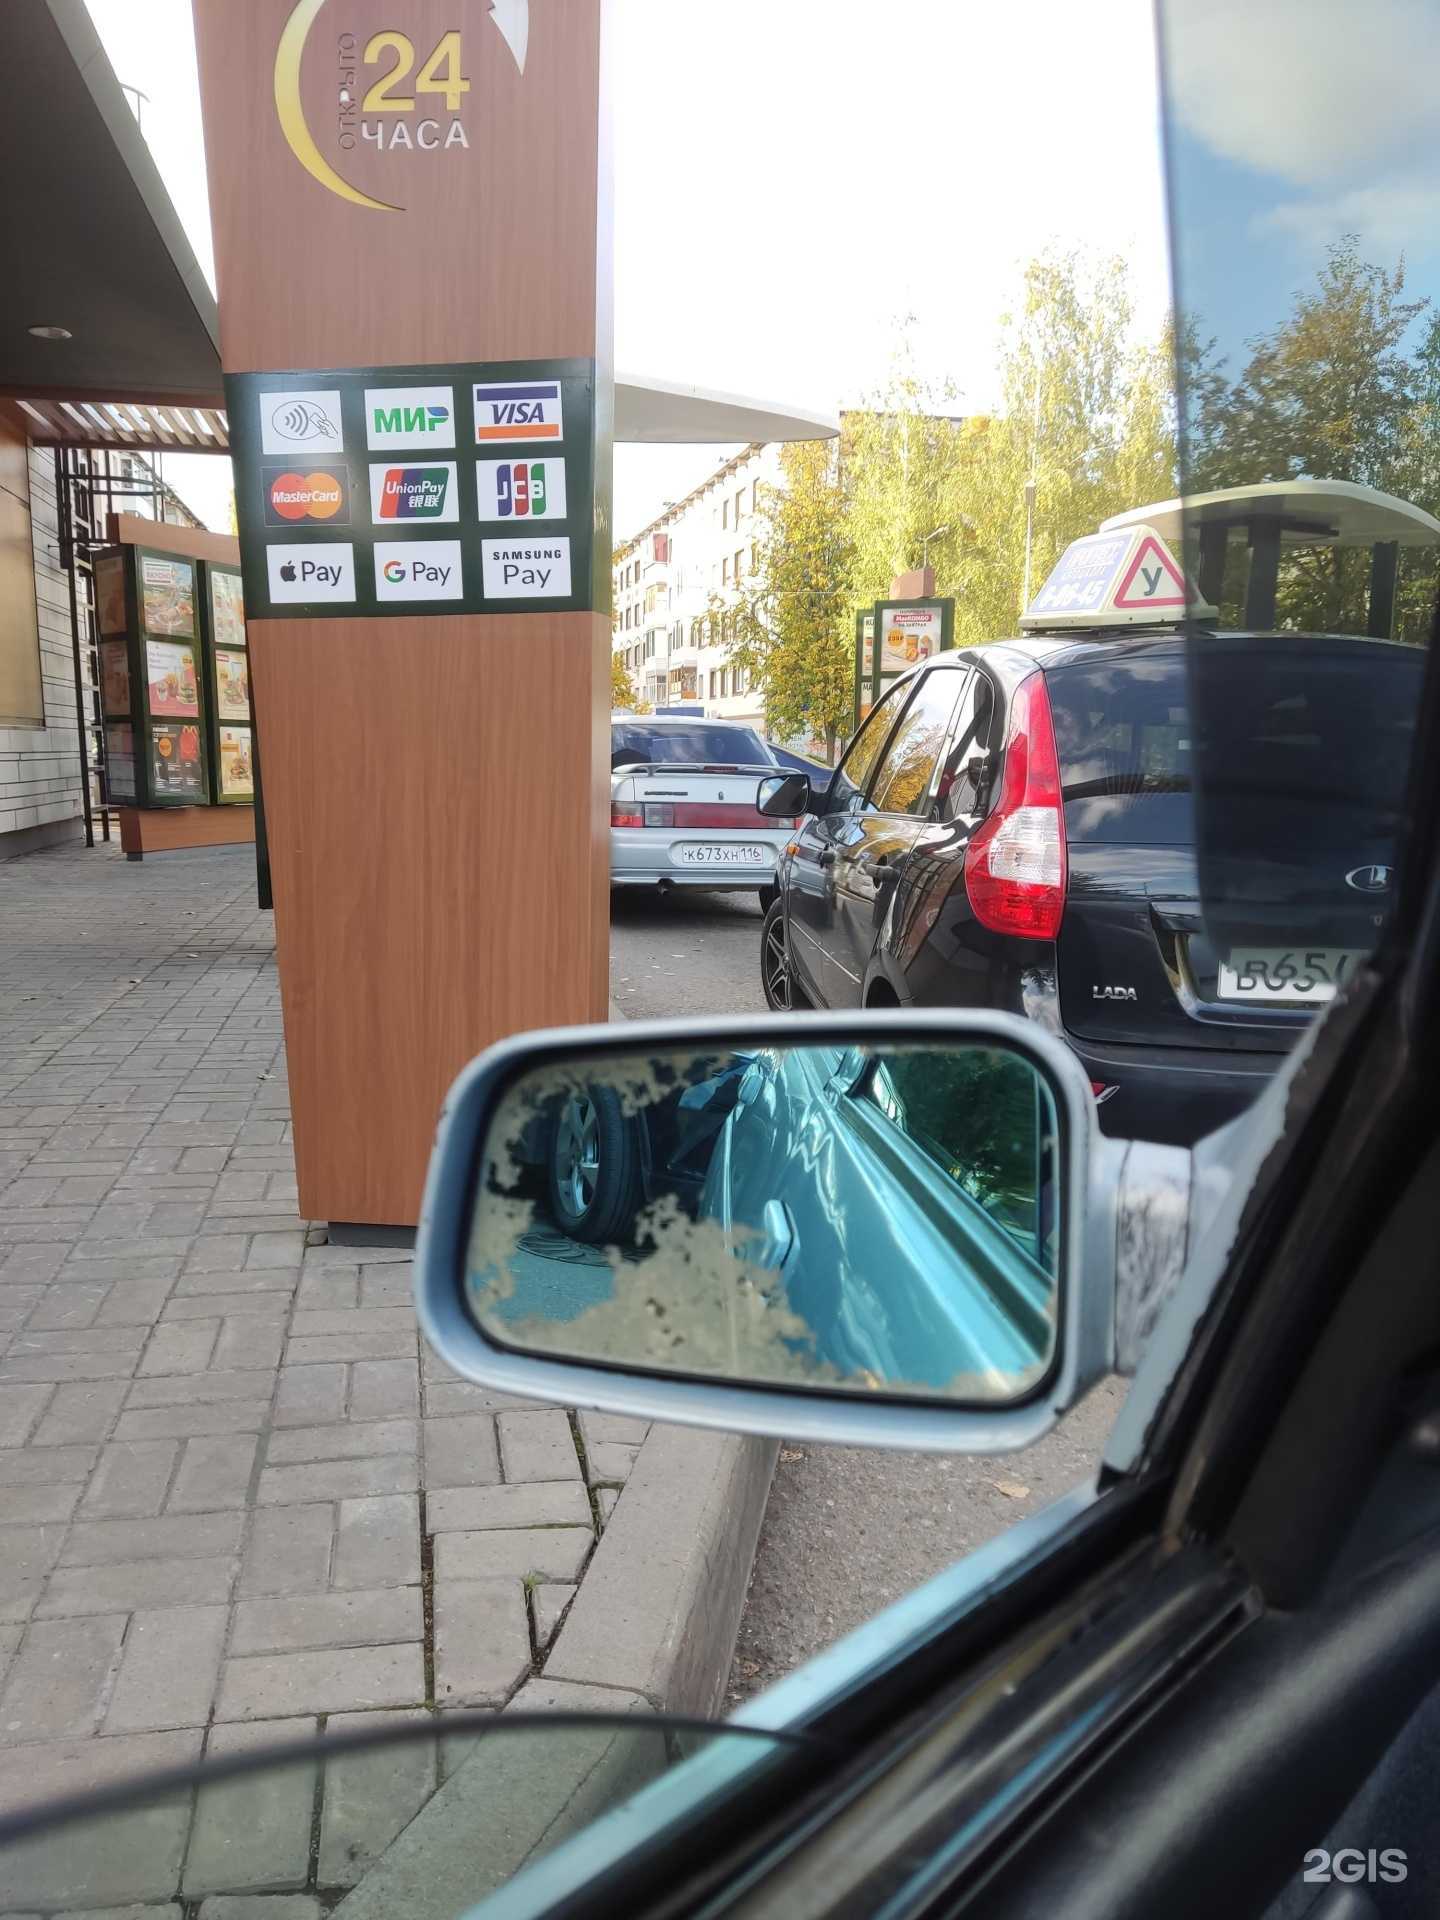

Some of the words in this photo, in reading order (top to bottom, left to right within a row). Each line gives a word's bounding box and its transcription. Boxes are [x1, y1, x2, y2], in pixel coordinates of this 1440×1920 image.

[362, 30, 471, 112] 24
[338, 32, 356, 150] ОТКРЫТО
[361, 118, 470, 150] ЧАСА
[374, 406, 449, 433] МИР
[490, 402, 545, 425] VISA
[272, 489, 340, 505] MasterCard
[386, 479, 445, 497] UnionPay
[407, 495, 440, 508] 银联
[492, 549, 562, 561] SAMSUNG
[301, 561, 342, 586] Pay
[412, 562, 451, 586] Pay
[503, 564, 552, 588] Pay
[1092, 985, 1138, 1001] LADA
